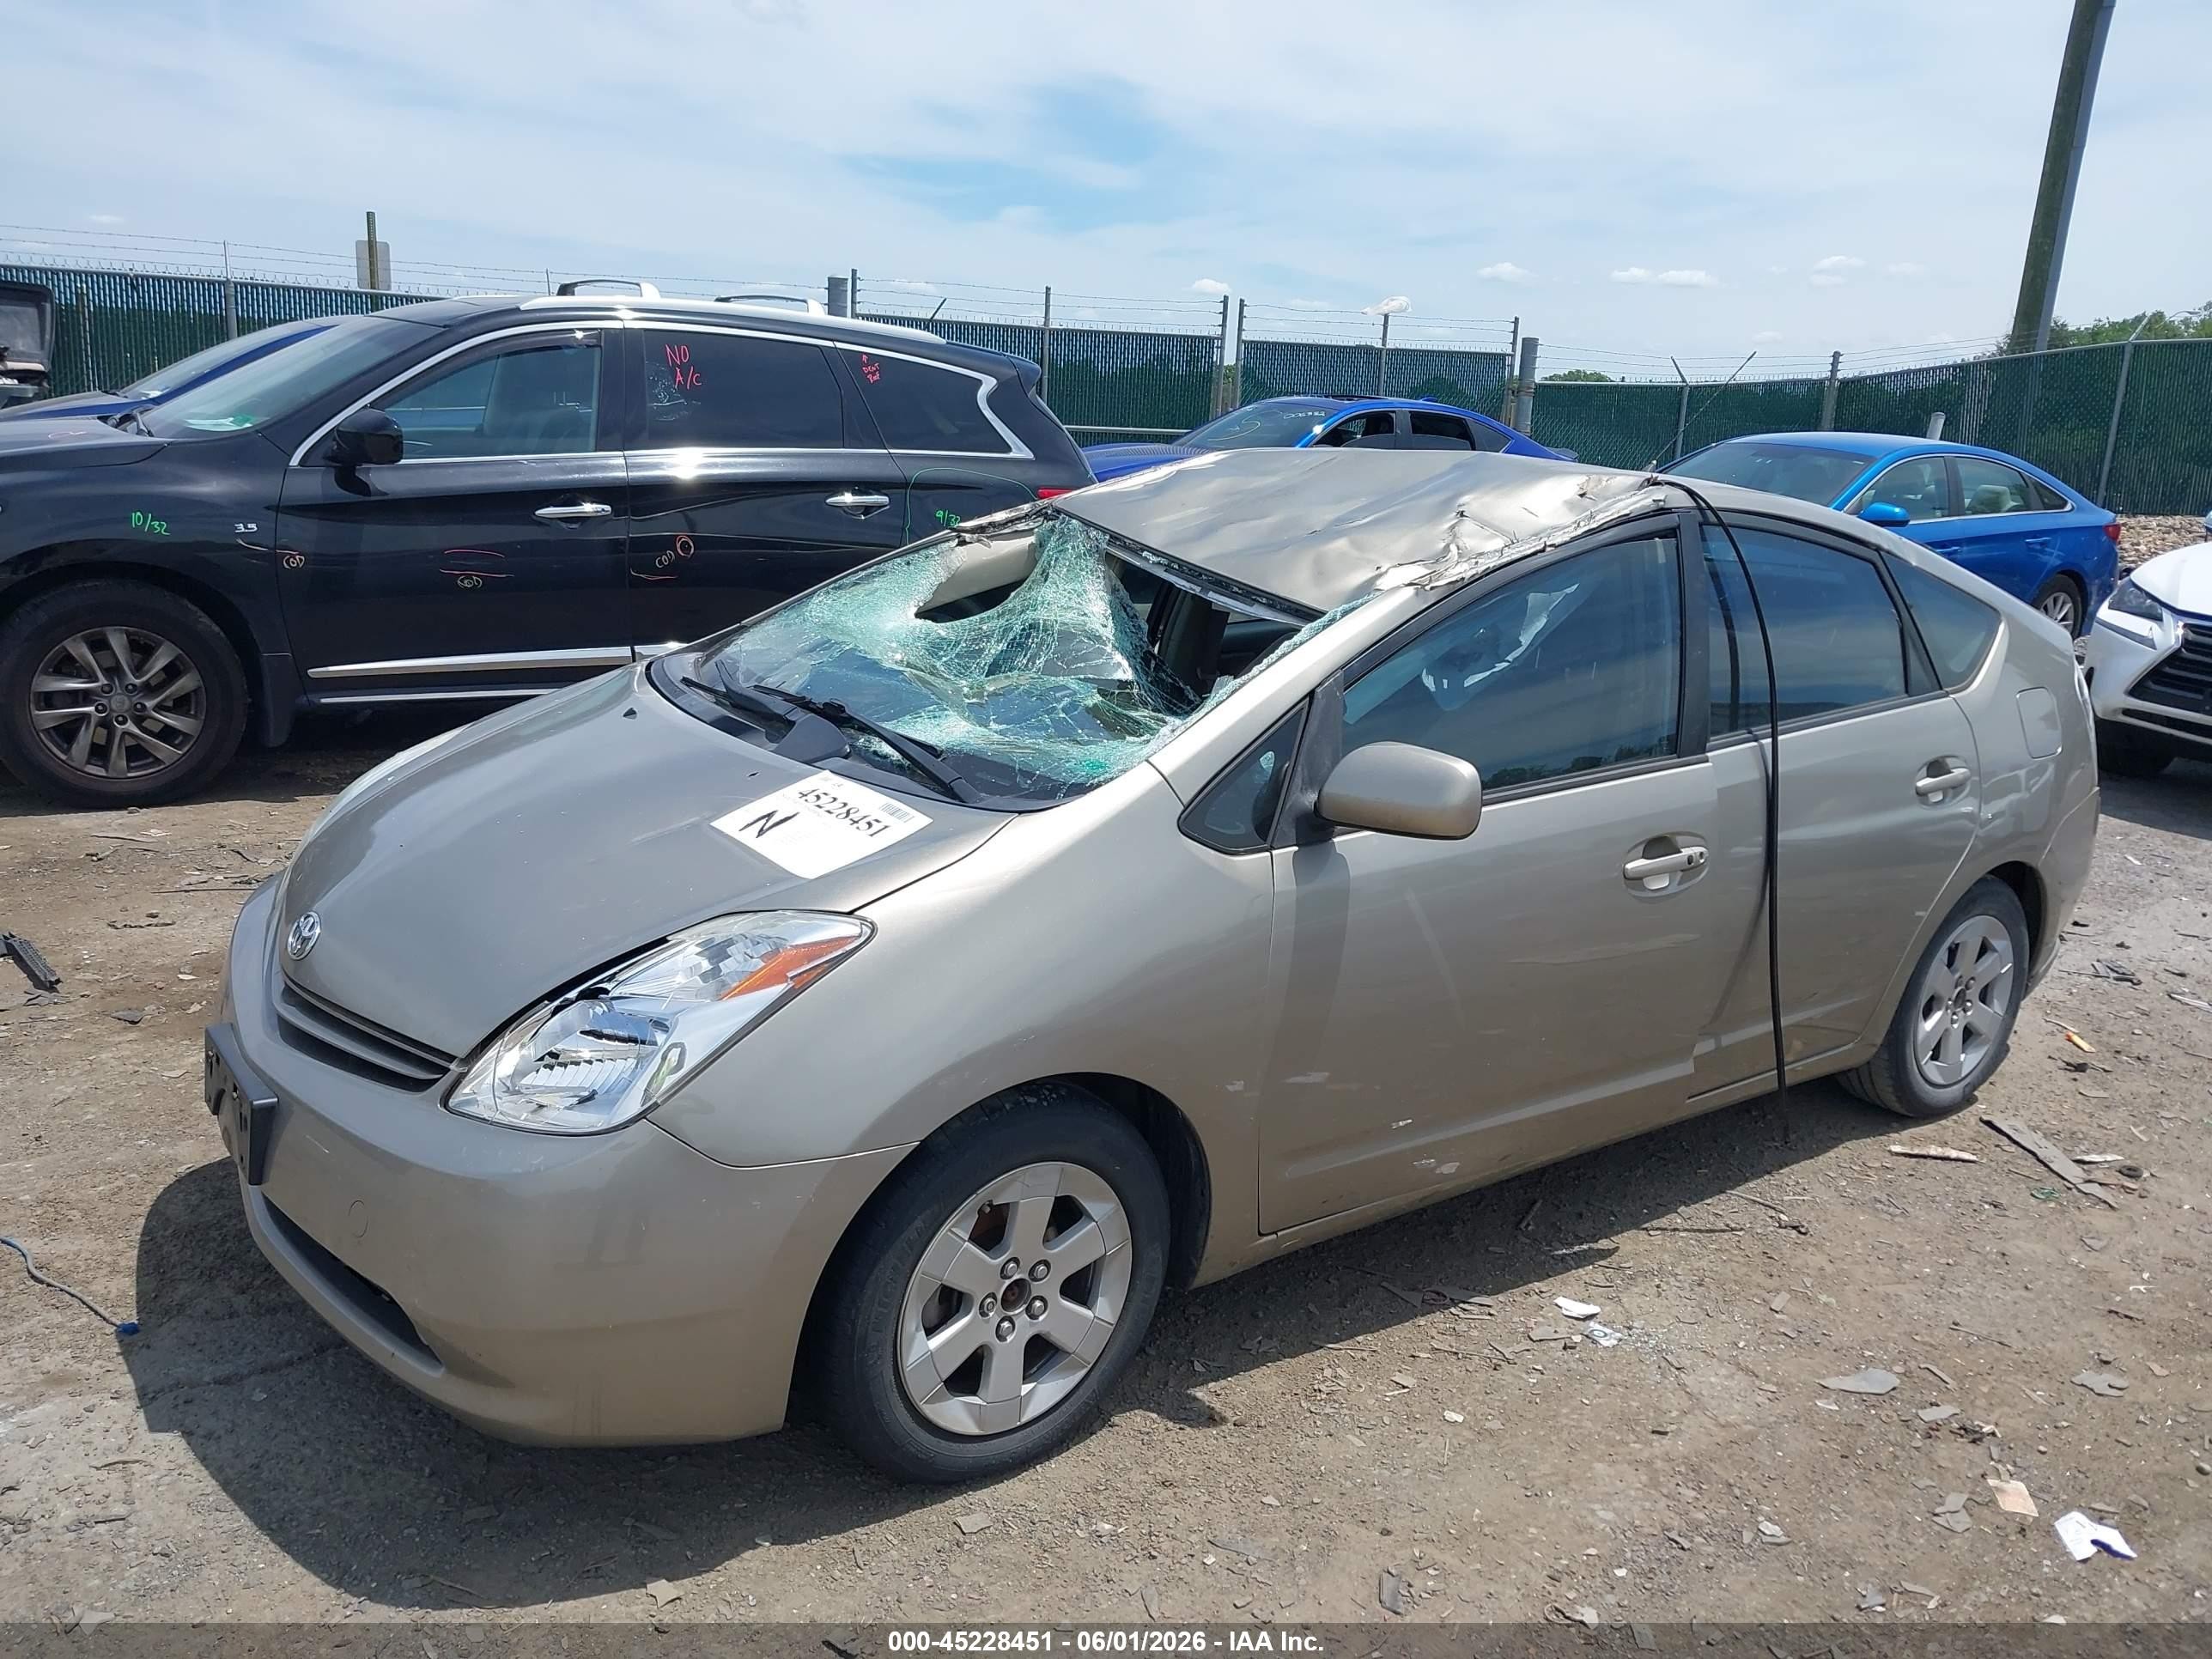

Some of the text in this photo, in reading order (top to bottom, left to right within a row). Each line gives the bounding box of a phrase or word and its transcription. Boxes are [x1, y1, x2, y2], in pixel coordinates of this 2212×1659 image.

[665, 343, 690, 367] NO
[675, 365, 702, 390] A/C
[131, 511, 171, 536] 10/32
[935, 509, 961, 529] 9/32
[797, 787, 892, 837] 45228451
